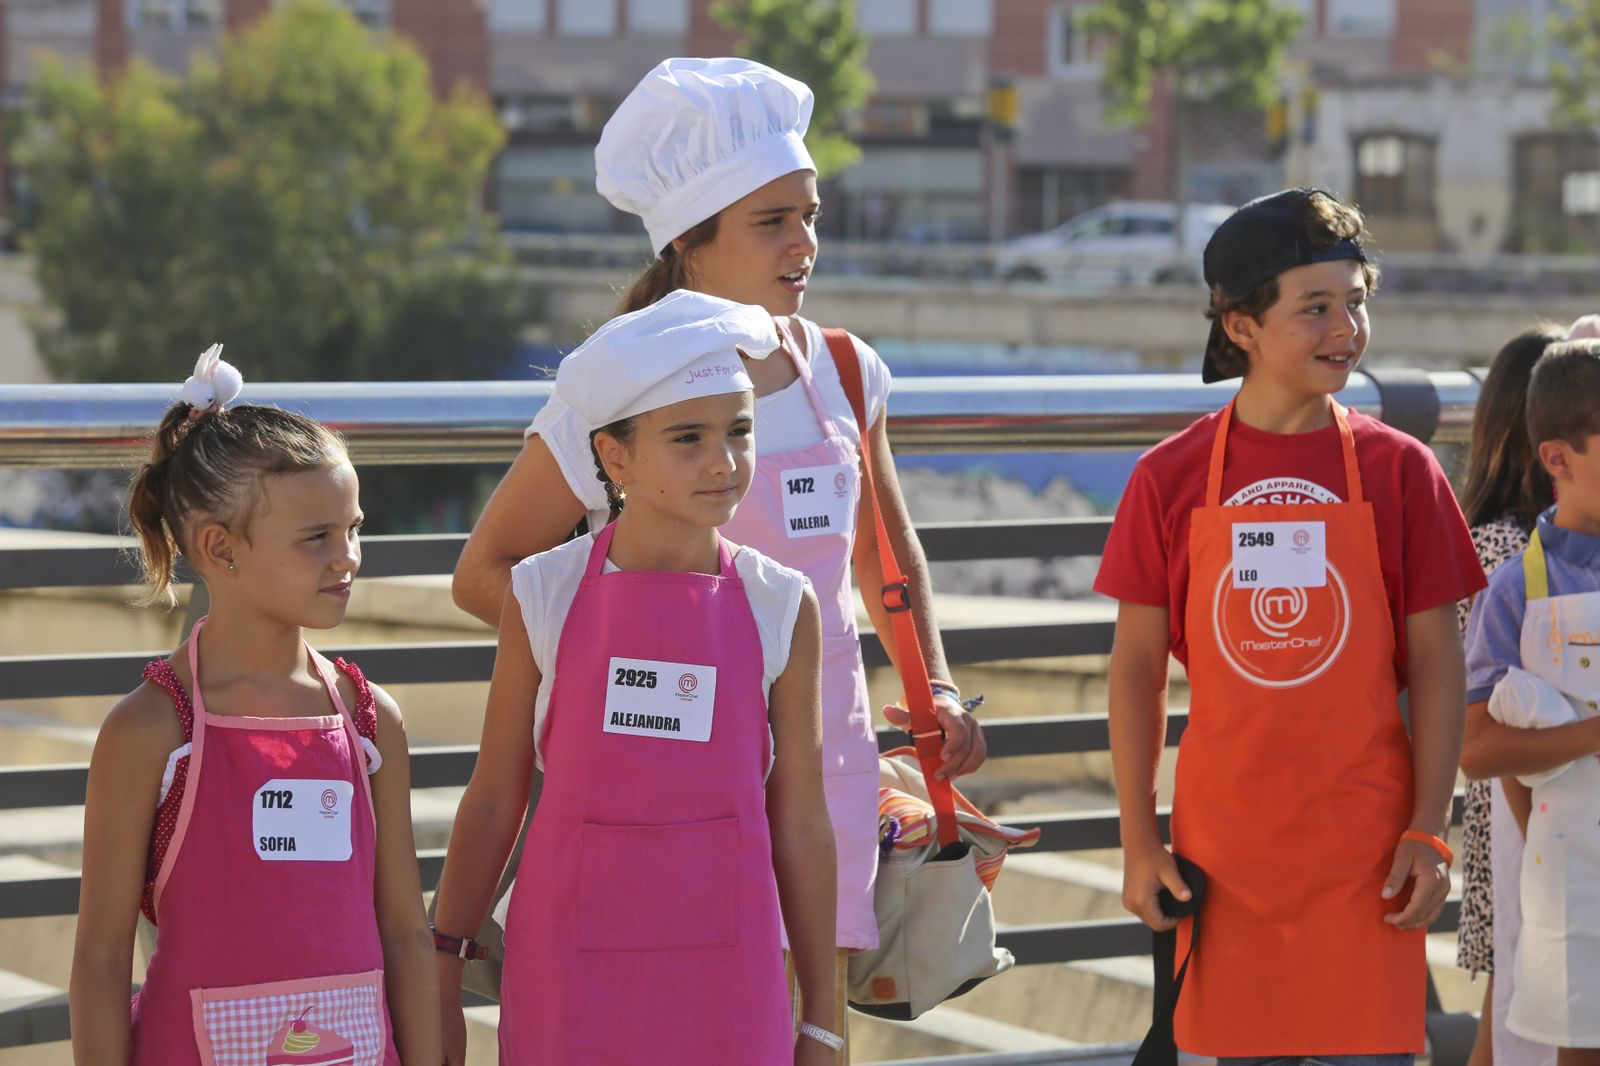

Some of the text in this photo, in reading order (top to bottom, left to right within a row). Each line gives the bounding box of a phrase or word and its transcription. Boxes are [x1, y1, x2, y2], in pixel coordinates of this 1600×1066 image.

[685, 366, 714, 384] Just
[715, 365, 731, 376] For
[787, 477, 815, 495] 1472
[1240, 481, 1317, 499] AND APPAREL
[789, 515, 830, 531] VALERIA
[1238, 532, 1274, 547] 2549
[1239, 570, 1258, 581] LEO
[1240, 636, 1323, 652] MasterChef
[614, 667, 657, 689] 2925
[610, 711, 681, 732] ALEJANDRA
[260, 790, 293, 809] 1712
[259, 836, 297, 851] SOFIA
